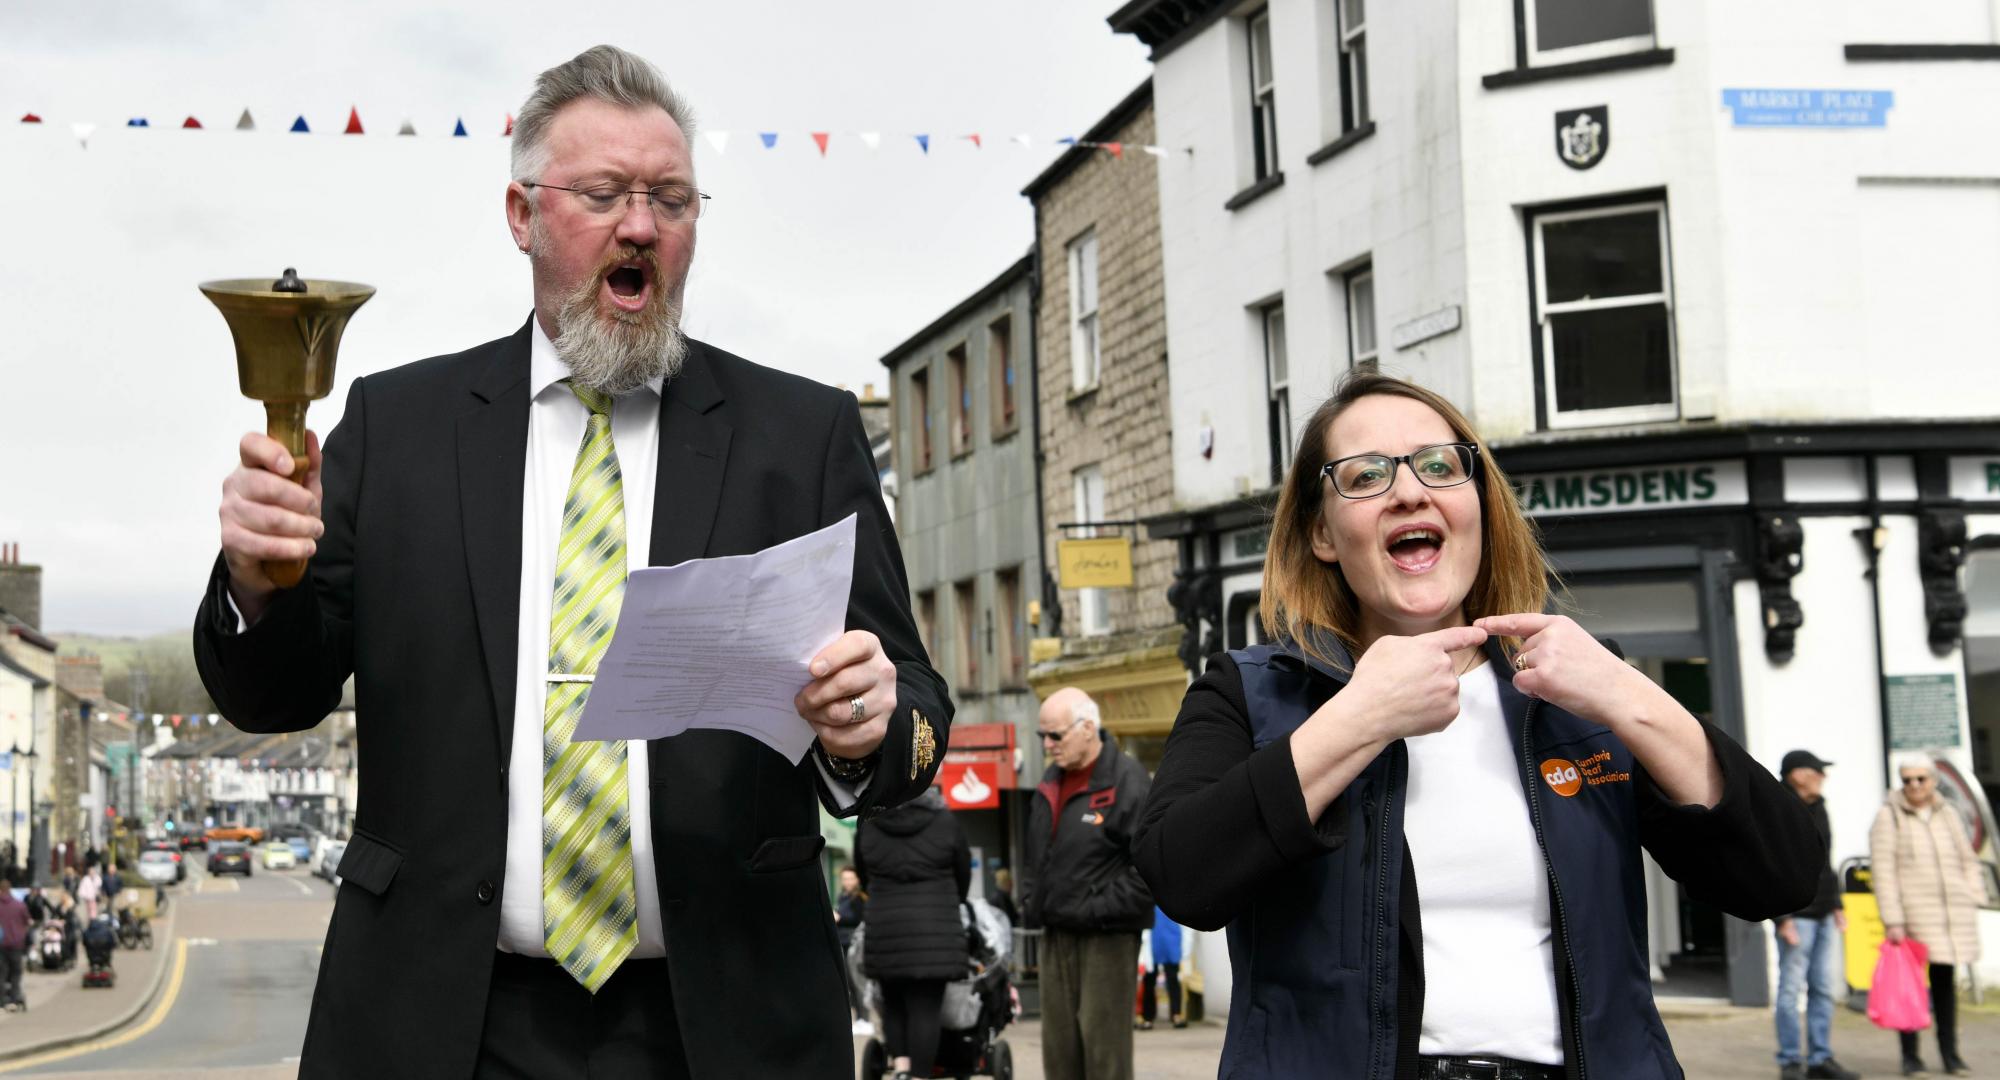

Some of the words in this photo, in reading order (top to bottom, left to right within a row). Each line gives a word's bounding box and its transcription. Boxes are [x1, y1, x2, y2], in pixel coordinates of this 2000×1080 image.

[1740, 91, 1811, 108] MARKET
[1822, 92, 1874, 109] PLACE
[1545, 766, 1578, 786] cda
[1581, 763, 1603, 776] Deaf
[1587, 771, 1630, 785] Association
